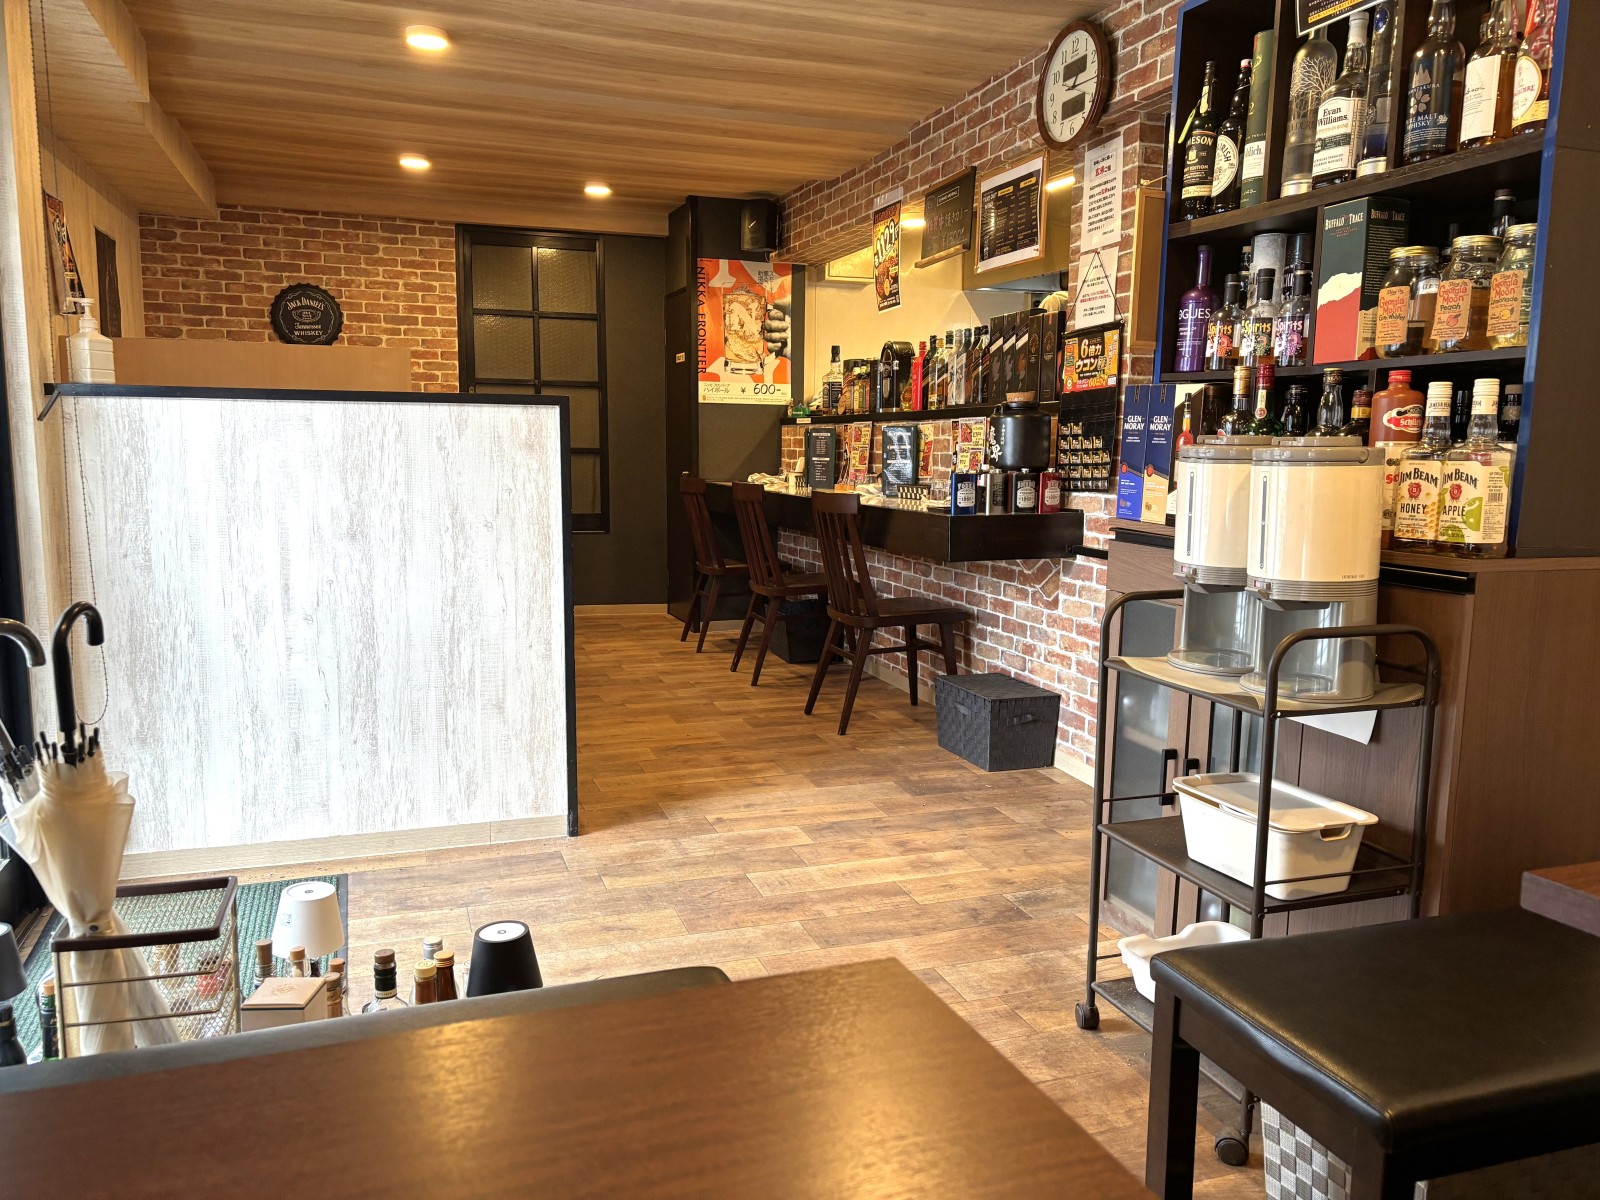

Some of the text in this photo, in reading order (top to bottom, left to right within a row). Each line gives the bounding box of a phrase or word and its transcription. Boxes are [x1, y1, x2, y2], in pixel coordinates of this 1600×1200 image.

[1072, 37, 1080, 54] 12
[1061, 50, 1068, 65] 11
[1091, 49, 1096, 64] 2
[1053, 70, 1060, 86] 10
[1050, 93, 1055, 108] 9
[1052, 111, 1058, 125] 8
[1322, 107, 1342, 118] Evan
[1418, 112, 1438, 122] MALT
[1058, 122, 1064, 138] 7
[1070, 122, 1074, 136] 6
[1325, 212, 1364, 230] BUFFALO TRACE
[1370, 209, 1405, 221] BUFFALO TRACE
[697, 266, 706, 307] NIKKA
[1492, 279, 1518, 290] Georgia
[1438, 285, 1467, 298] Georgia
[1494, 288, 1515, 297] Moon
[286, 300, 301, 310] JACK
[1380, 296, 1404, 308] Georgia
[1442, 296, 1464, 304] Moon
[1490, 297, 1518, 305] Lemonade
[1382, 306, 1402, 316] Moon
[294, 322, 322, 330] Tennessee
[1244, 320, 1271, 334] Spirits
[1277, 318, 1302, 332] Spirits
[697, 314, 706, 374] FRONTIER
[1081, 339, 1102, 358] 6倍力
[1076, 358, 1098, 373] ウコン
[1127, 415, 1142, 423] GLEN
[1124, 423, 1145, 431] MORAY
[1150, 423, 1171, 431] MORAY
[1400, 472, 1412, 487] JIM
[1415, 468, 1439, 489] BEAM
[1456, 468, 1479, 489] BEAM
[1400, 503, 1428, 514] HONEY
[1442, 505, 1466, 516] APPLE
